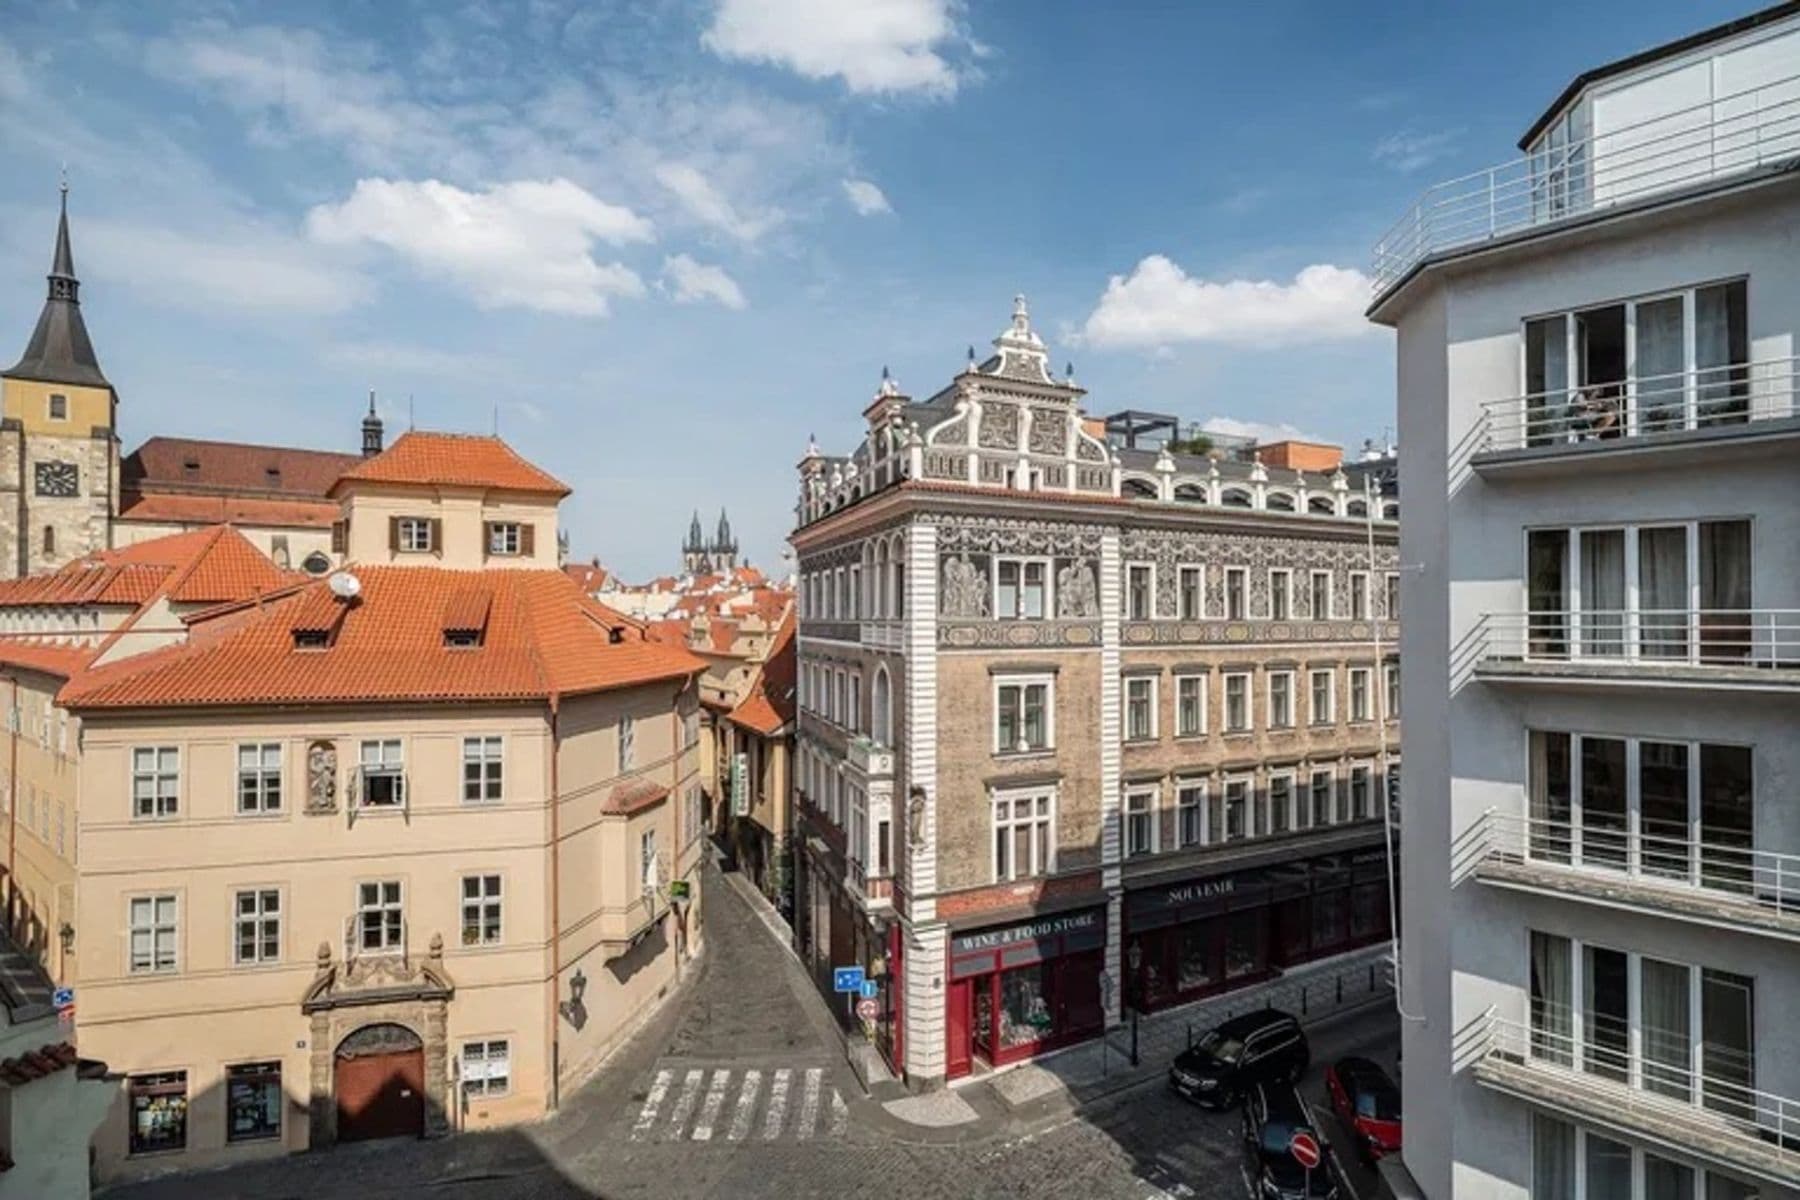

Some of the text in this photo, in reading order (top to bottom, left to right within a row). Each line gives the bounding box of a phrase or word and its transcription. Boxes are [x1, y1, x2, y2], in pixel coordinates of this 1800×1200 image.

[1168, 880, 1235, 903] SOUVENIR
[962, 914, 1095, 949] WINE & FOOD STORE
